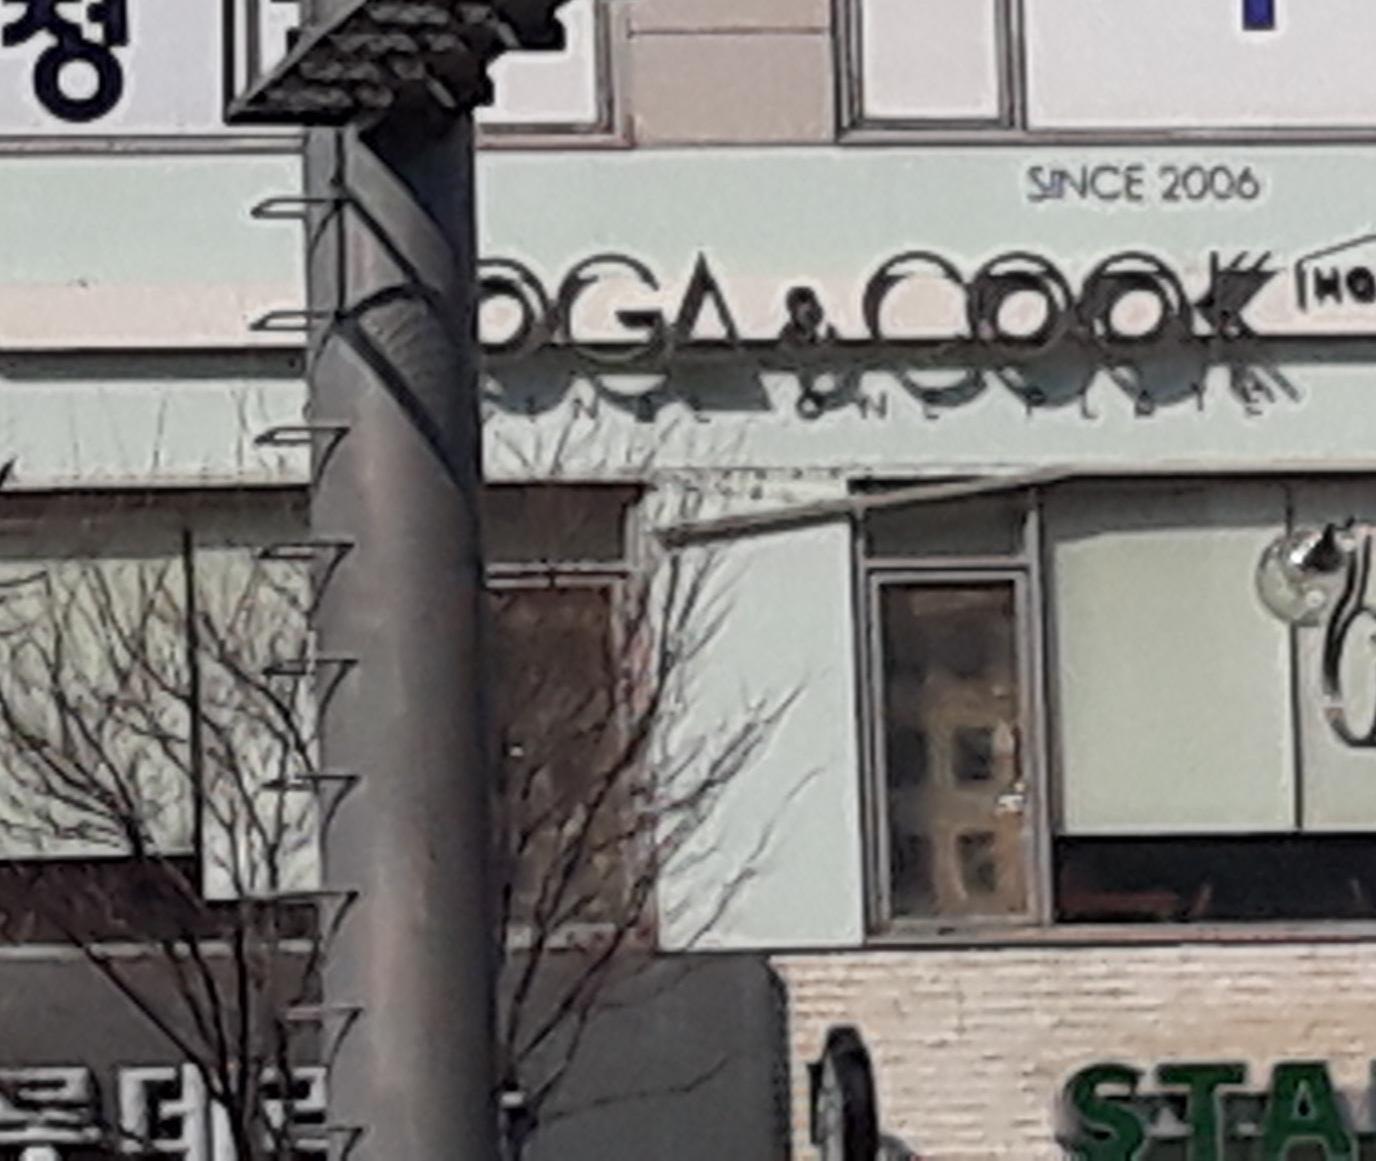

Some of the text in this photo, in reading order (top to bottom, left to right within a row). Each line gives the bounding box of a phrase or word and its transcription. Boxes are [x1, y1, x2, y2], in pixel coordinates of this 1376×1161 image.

[1025, 163, 1262, 203] SINCE 2006
[862, 249, 1279, 357] COOK
